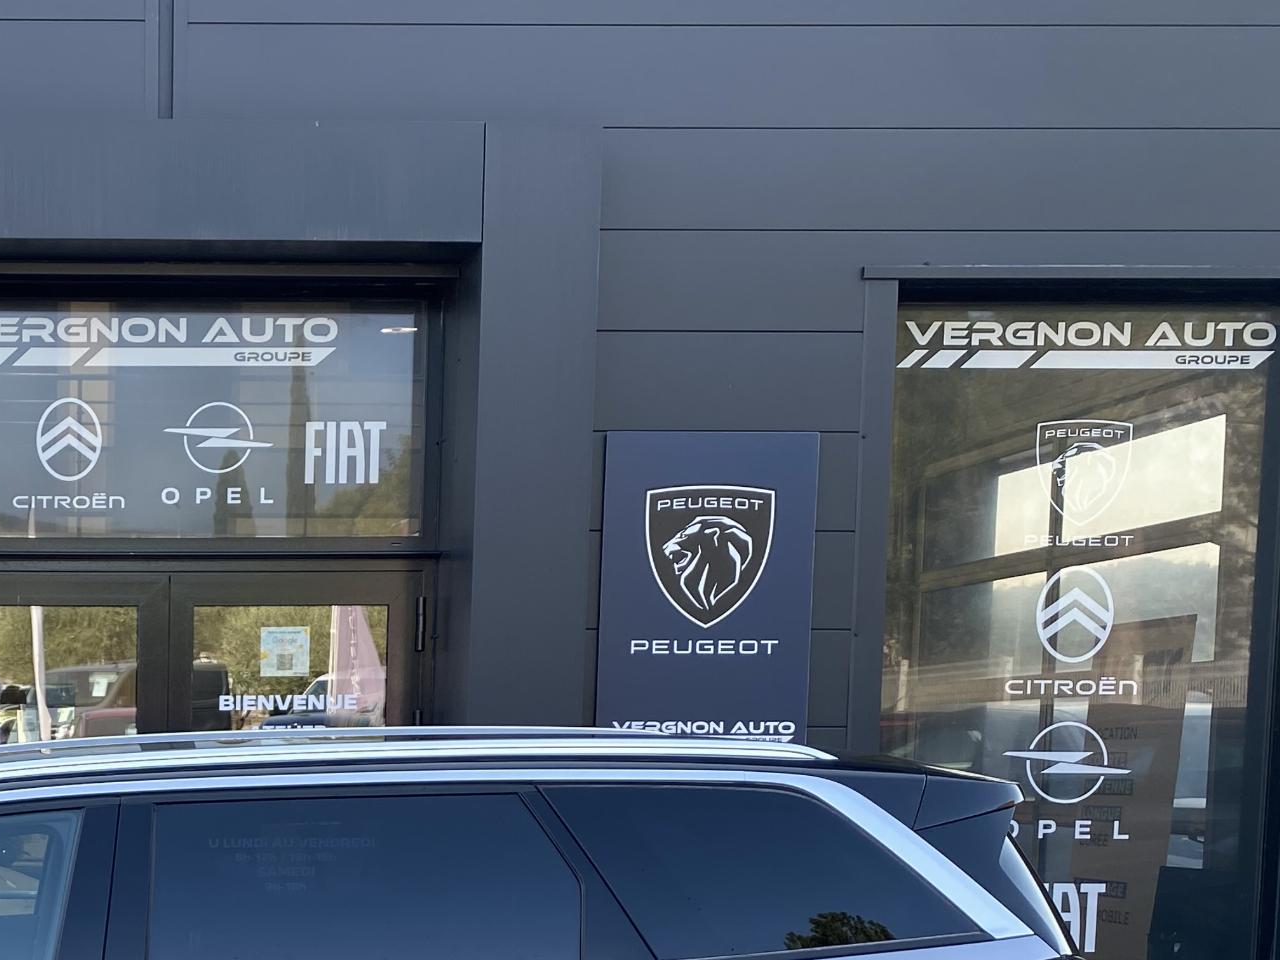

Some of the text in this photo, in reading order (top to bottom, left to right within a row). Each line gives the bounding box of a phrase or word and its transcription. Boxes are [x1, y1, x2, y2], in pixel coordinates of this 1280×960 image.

[201, 317, 338, 343] AUTO
[905, 320, 1277, 347] VERGNON AUTO
[233, 351, 313, 362] GROUPE
[1175, 354, 1251, 365] GROUPE
[1045, 428, 1125, 439] PEUGEOT
[304, 420, 387, 485] FIAT
[161, 487, 274, 505] OPEL
[657, 497, 764, 511] PEUGEOT
[1024, 535, 1134, 547] PEUGEOT
[630, 639, 779, 655] PEUGEOT
[218, 694, 358, 711] BIENVENUE
[730, 721, 795, 734] AUTO
[1043, 883, 1106, 952] AT
